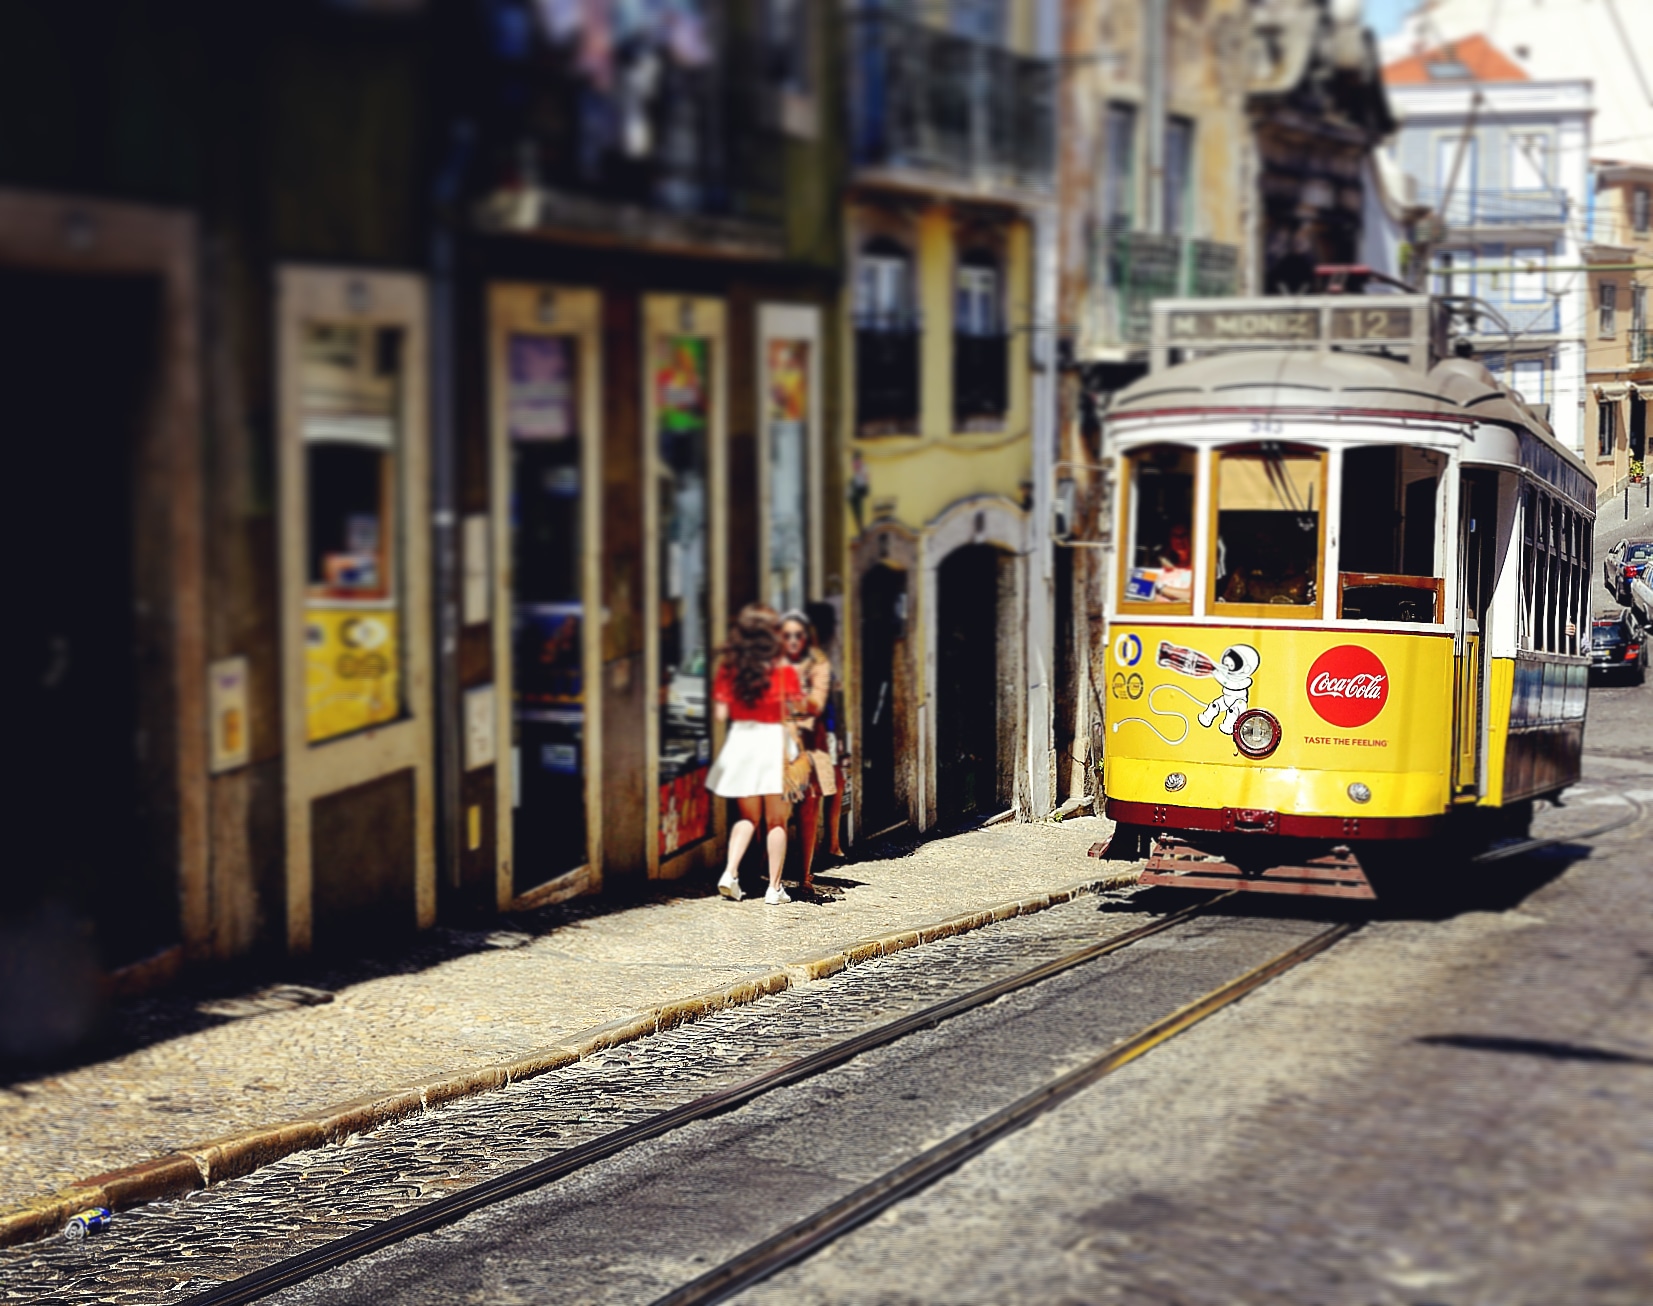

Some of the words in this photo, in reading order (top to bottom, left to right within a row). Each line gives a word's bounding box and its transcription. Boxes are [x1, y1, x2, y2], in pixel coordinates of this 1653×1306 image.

[1214, 314, 1308, 334] MONIZ
[1348, 310, 1389, 338] 12
[1310, 672, 1386, 699] Coca-Cola
[1304, 736, 1331, 744] TASTE
[1333, 737, 1350, 746] THE
[1352, 739, 1387, 747] FEELING
